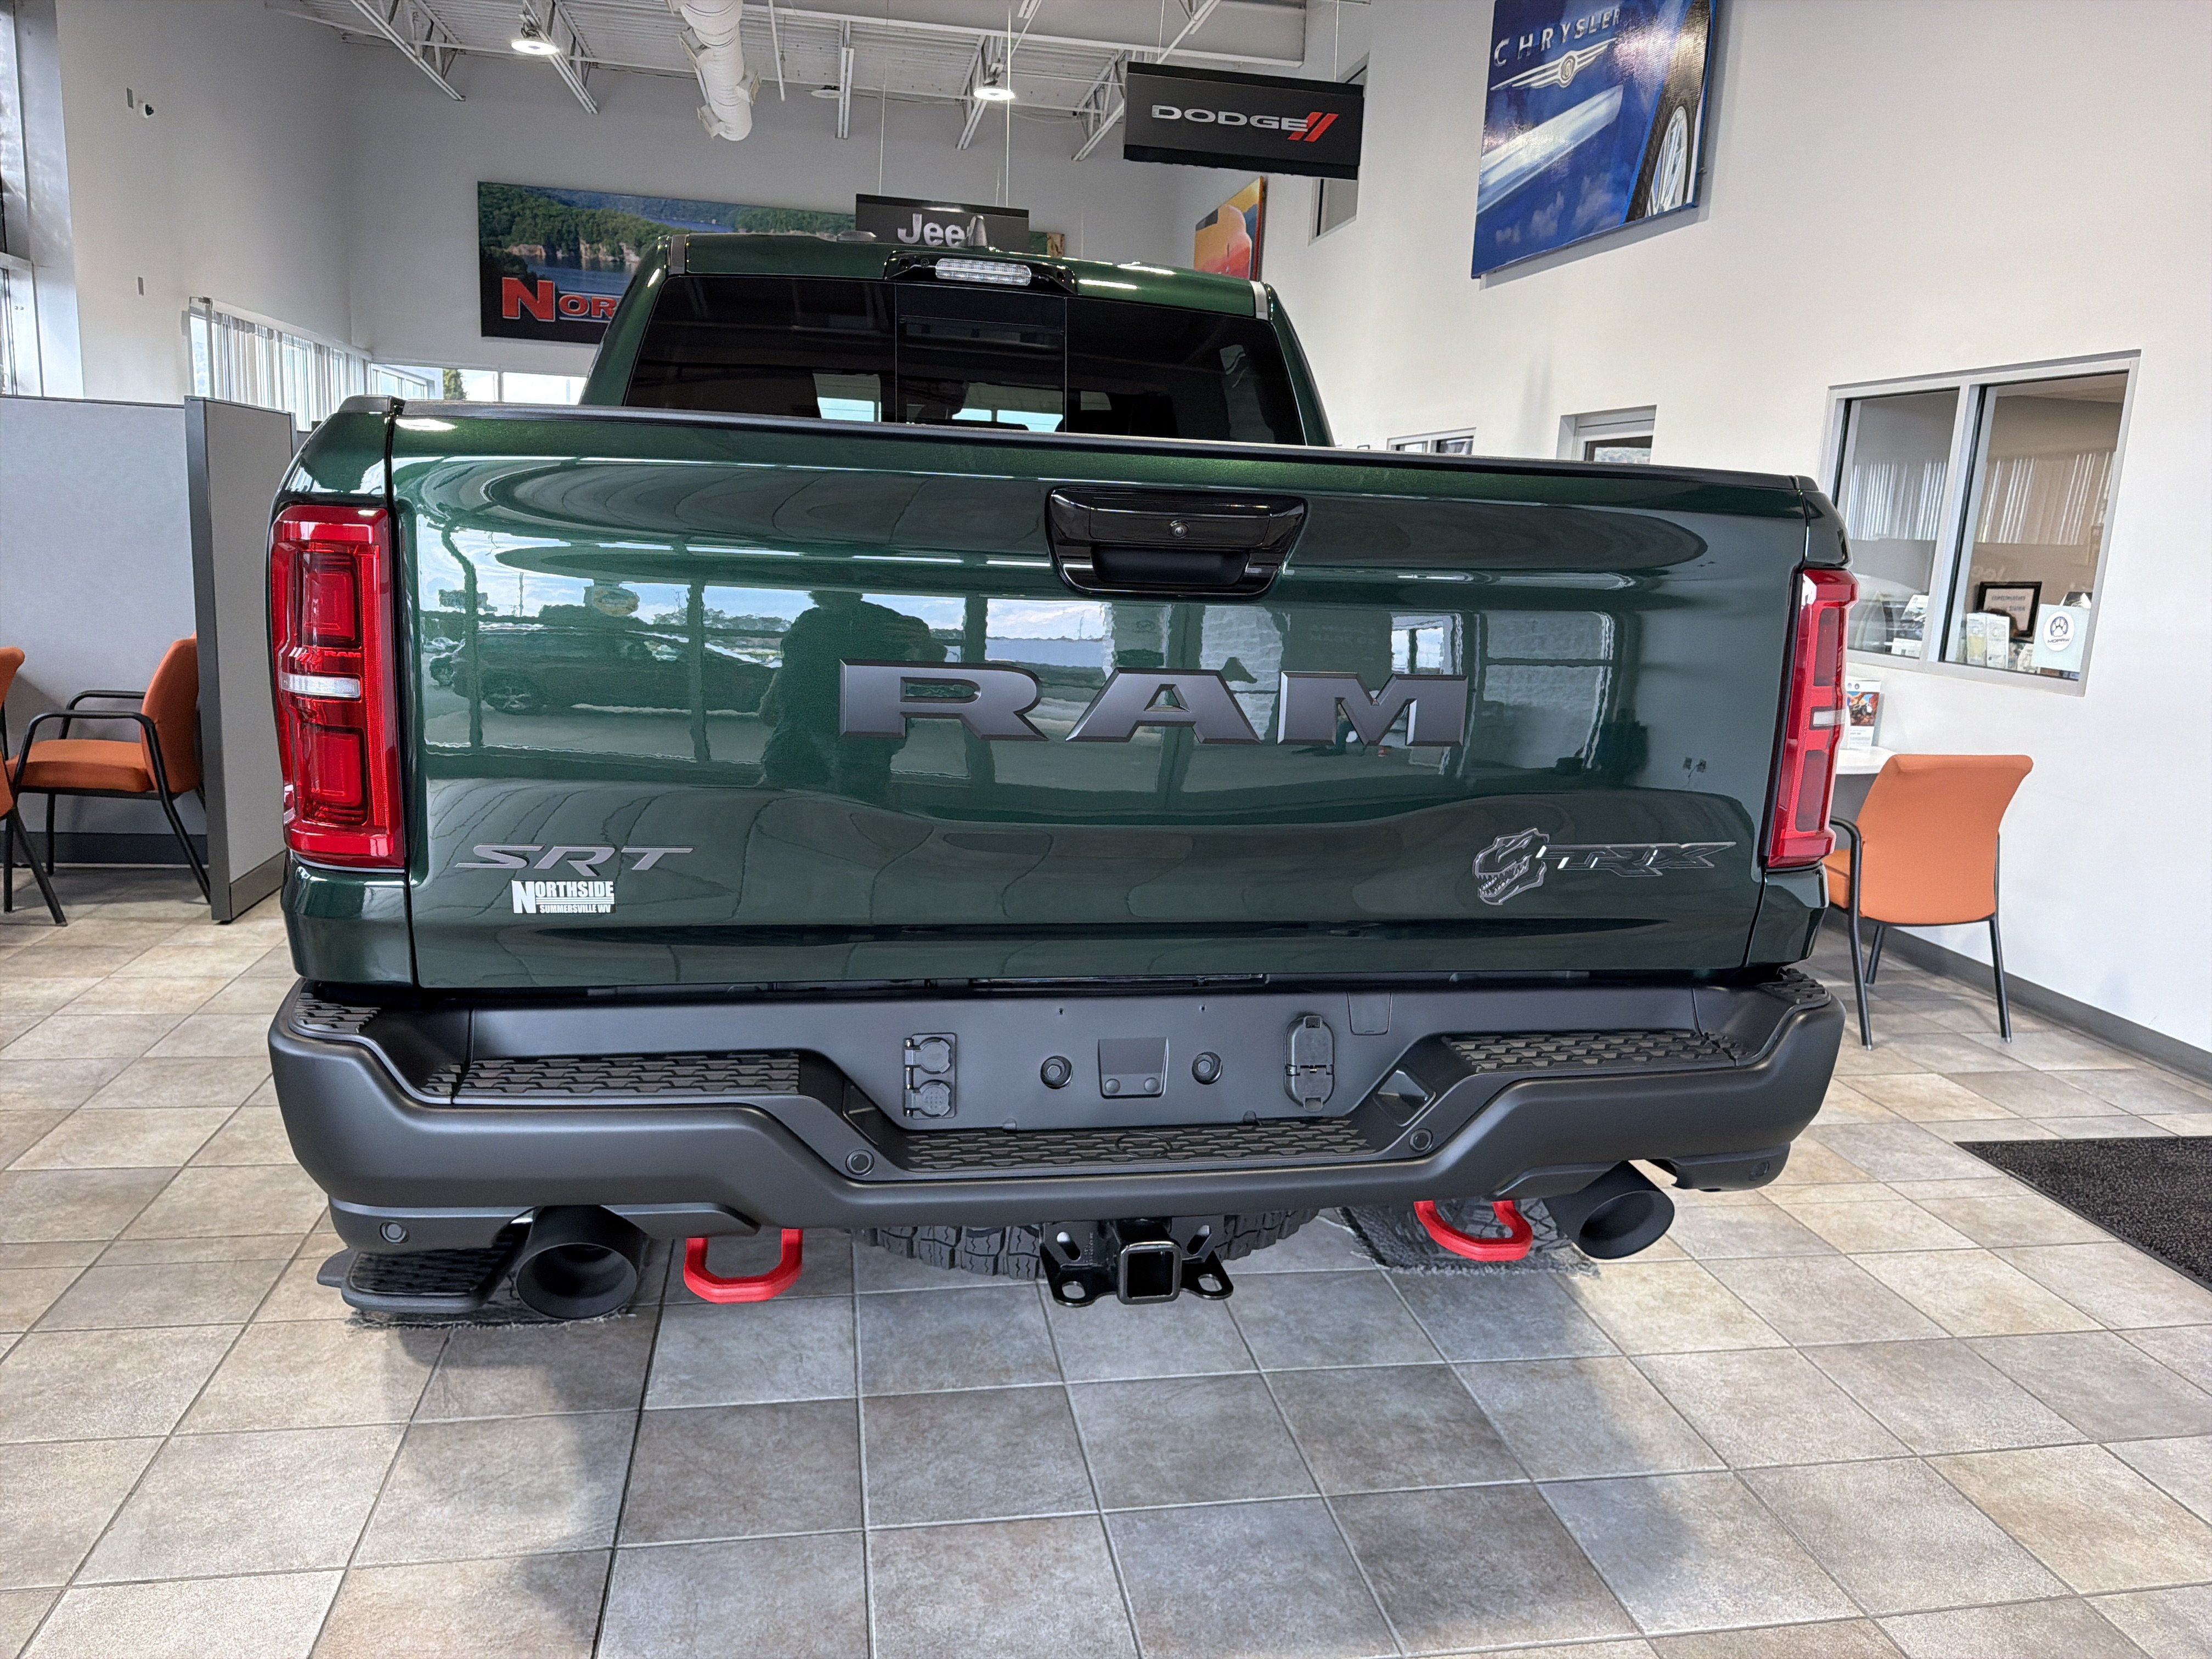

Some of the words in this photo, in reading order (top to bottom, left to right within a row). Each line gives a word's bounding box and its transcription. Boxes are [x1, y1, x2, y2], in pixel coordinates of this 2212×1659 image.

[1494, 8, 1621, 66] CHRYSLER
[1152, 105, 1308, 132] DODGE
[898, 213, 972, 247] Jee
[502, 276, 622, 322] NOR
[838, 658, 1469, 746] RAM
[455, 843, 696, 877] SRT
[1536, 842, 1737, 877] TRX
[511, 880, 615, 913] NORTHSIDE
[540, 904, 597, 913] SUMMERSVILLE
[597, 904, 611, 913] WV
